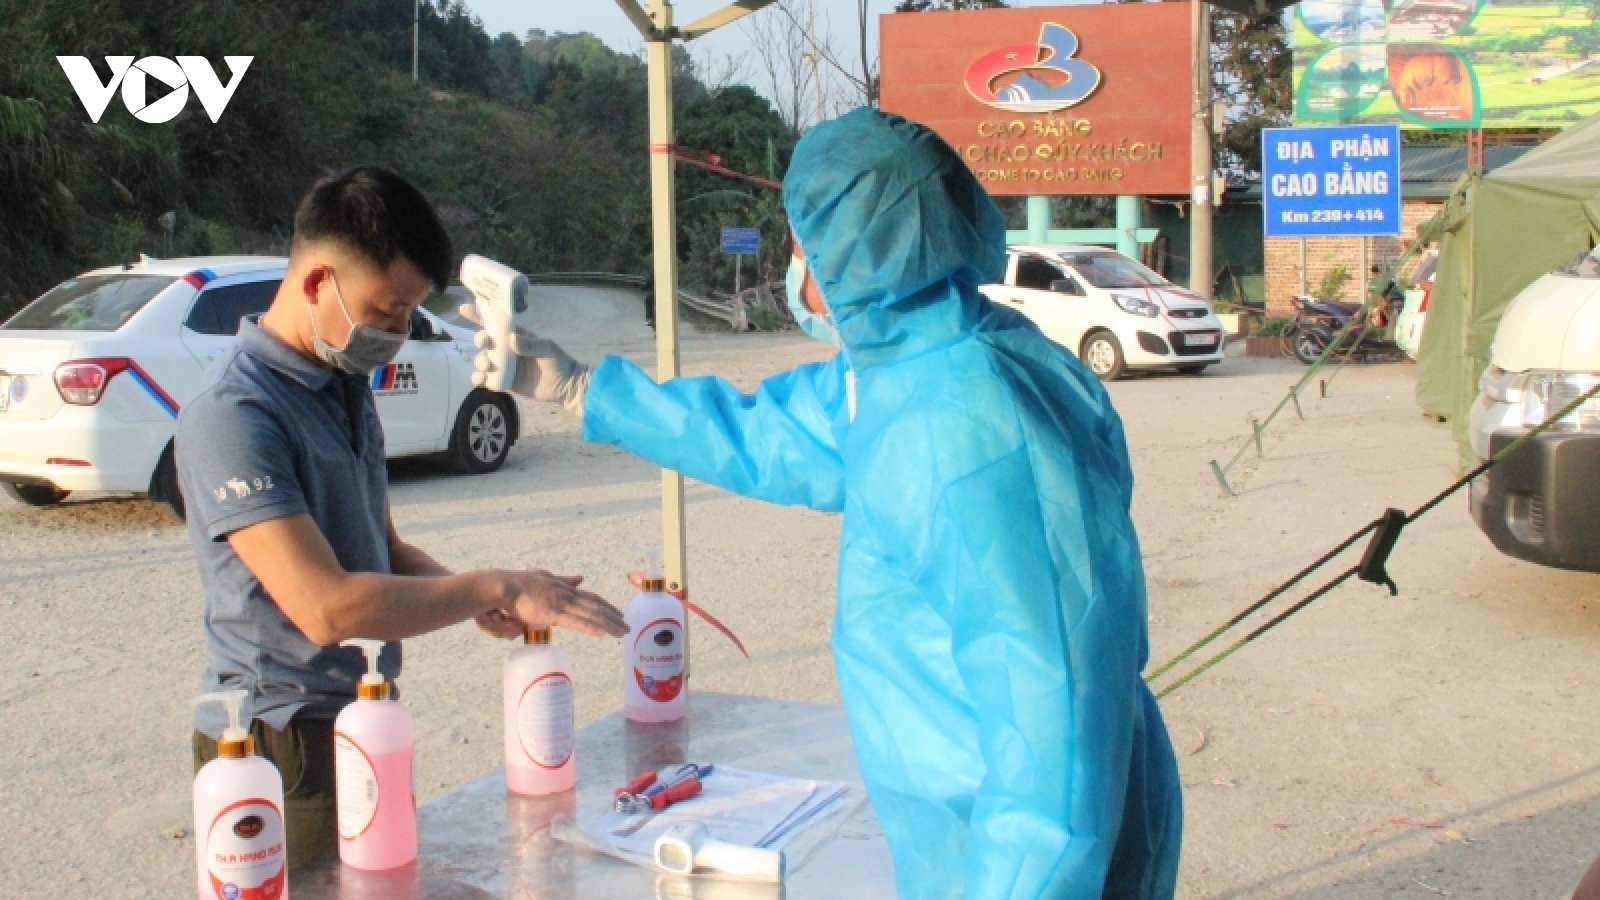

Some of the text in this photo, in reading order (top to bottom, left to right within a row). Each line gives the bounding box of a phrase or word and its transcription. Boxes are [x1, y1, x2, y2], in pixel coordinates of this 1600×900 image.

[977, 119, 1027, 139] CAO
[1276, 133, 1389, 164] ĐỊA PHẬN
[1271, 161, 1389, 197] CAO BẰNG
[1281, 210, 1309, 223] Km
